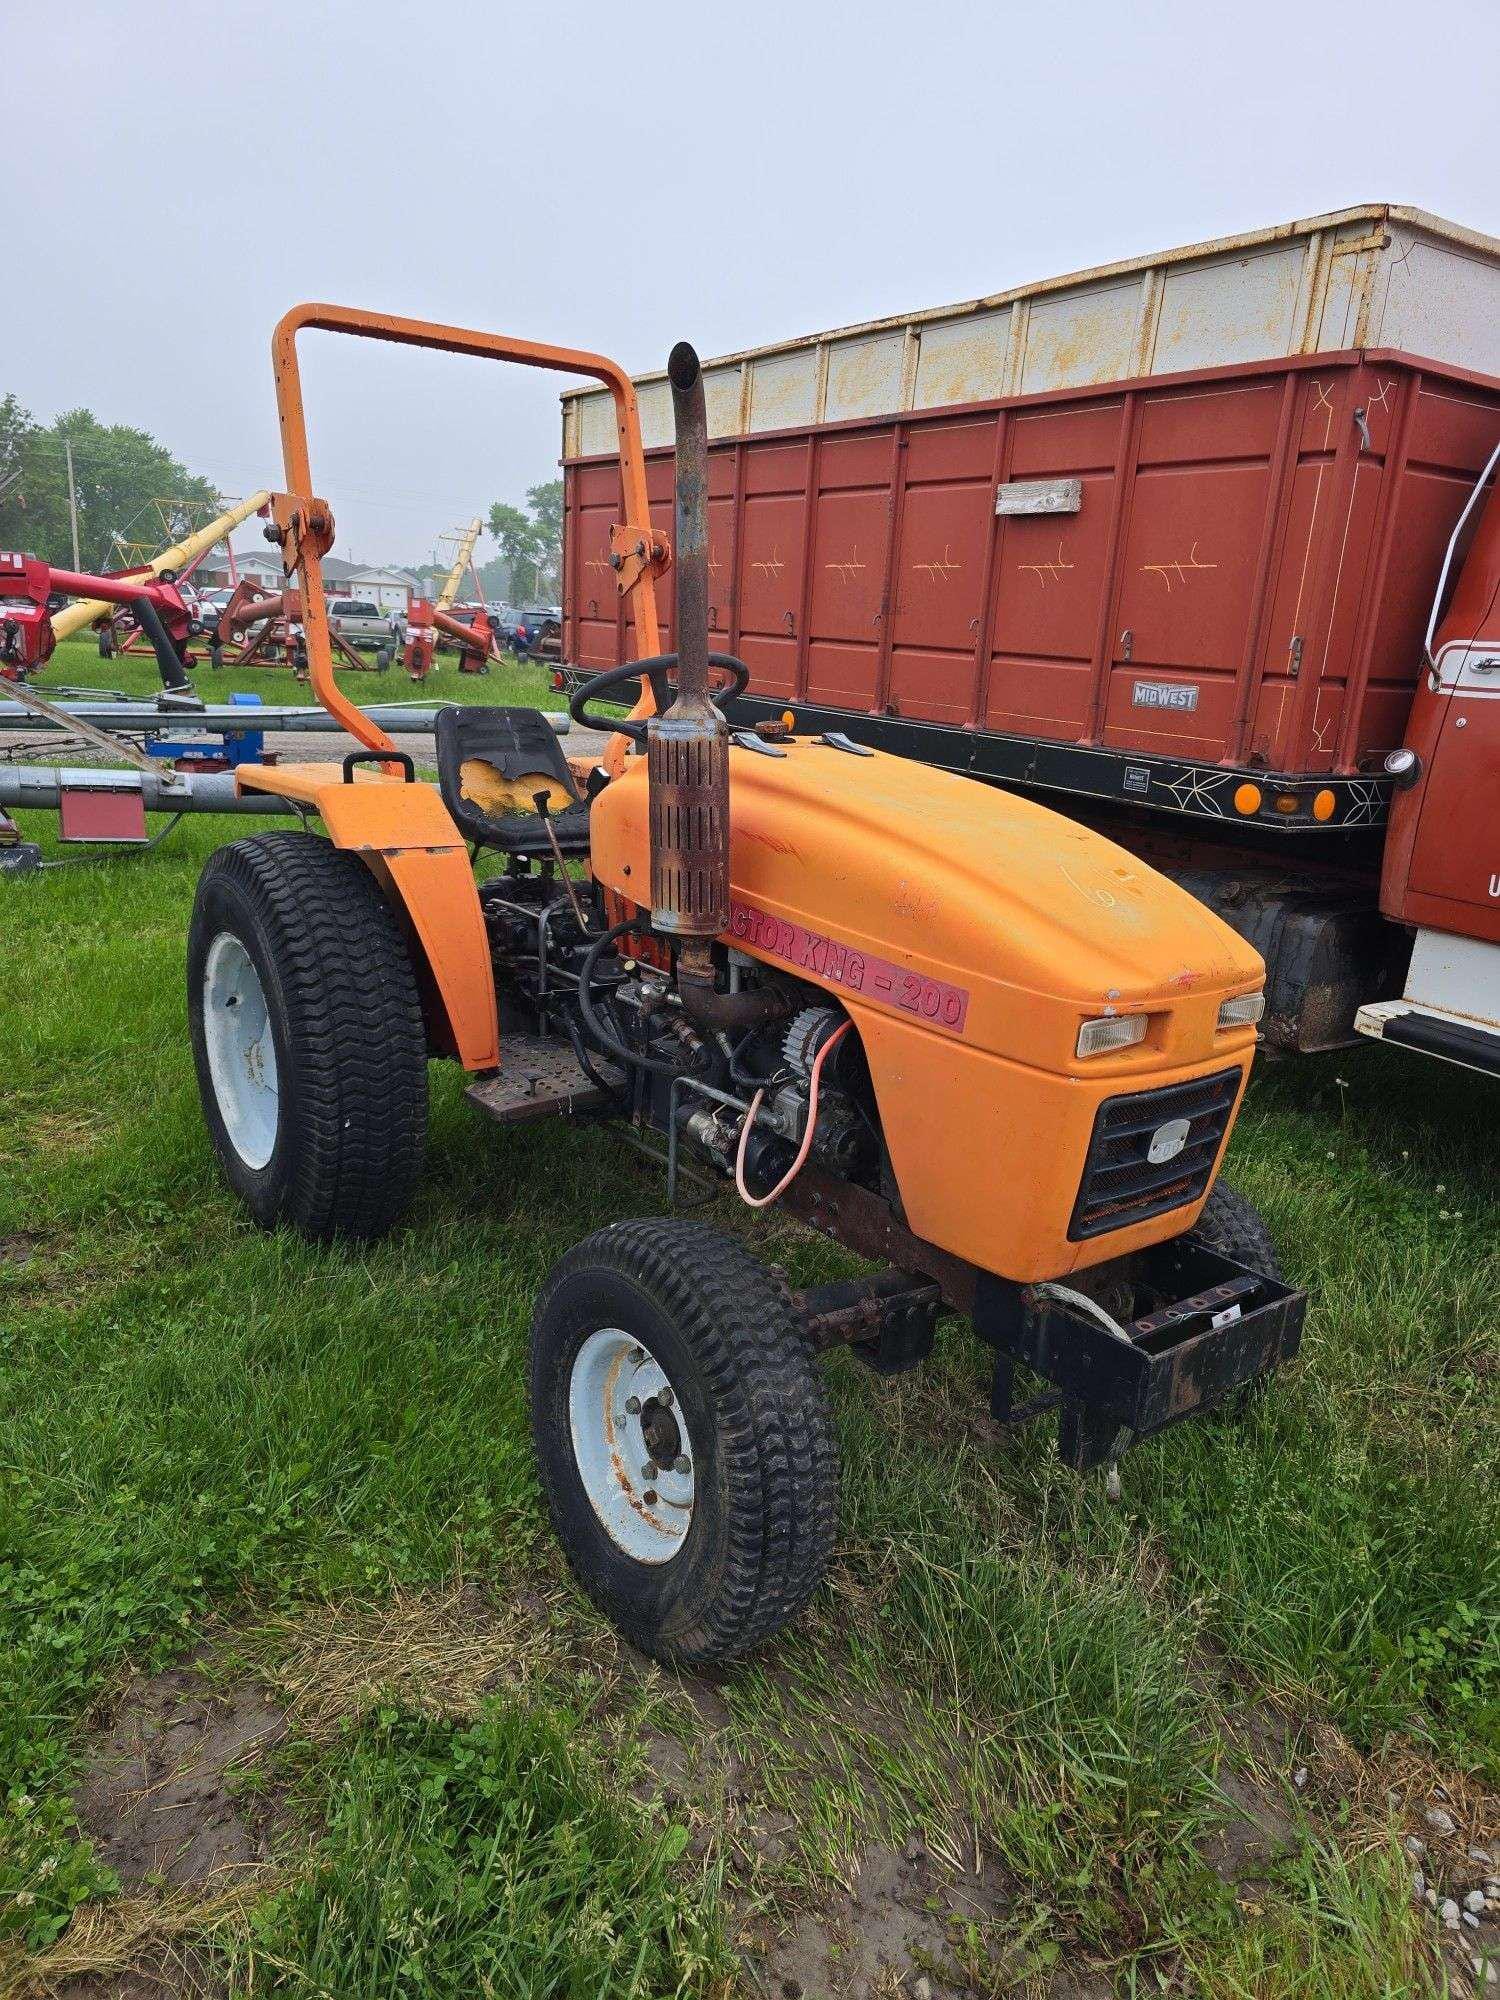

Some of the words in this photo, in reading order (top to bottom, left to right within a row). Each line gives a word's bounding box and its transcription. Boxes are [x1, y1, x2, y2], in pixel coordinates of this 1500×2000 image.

[1134, 684, 1197, 708] MIDWEST
[732, 907, 795, 960] CTOR
[799, 932, 866, 991] KING
[899, 975, 962, 1025] 200
